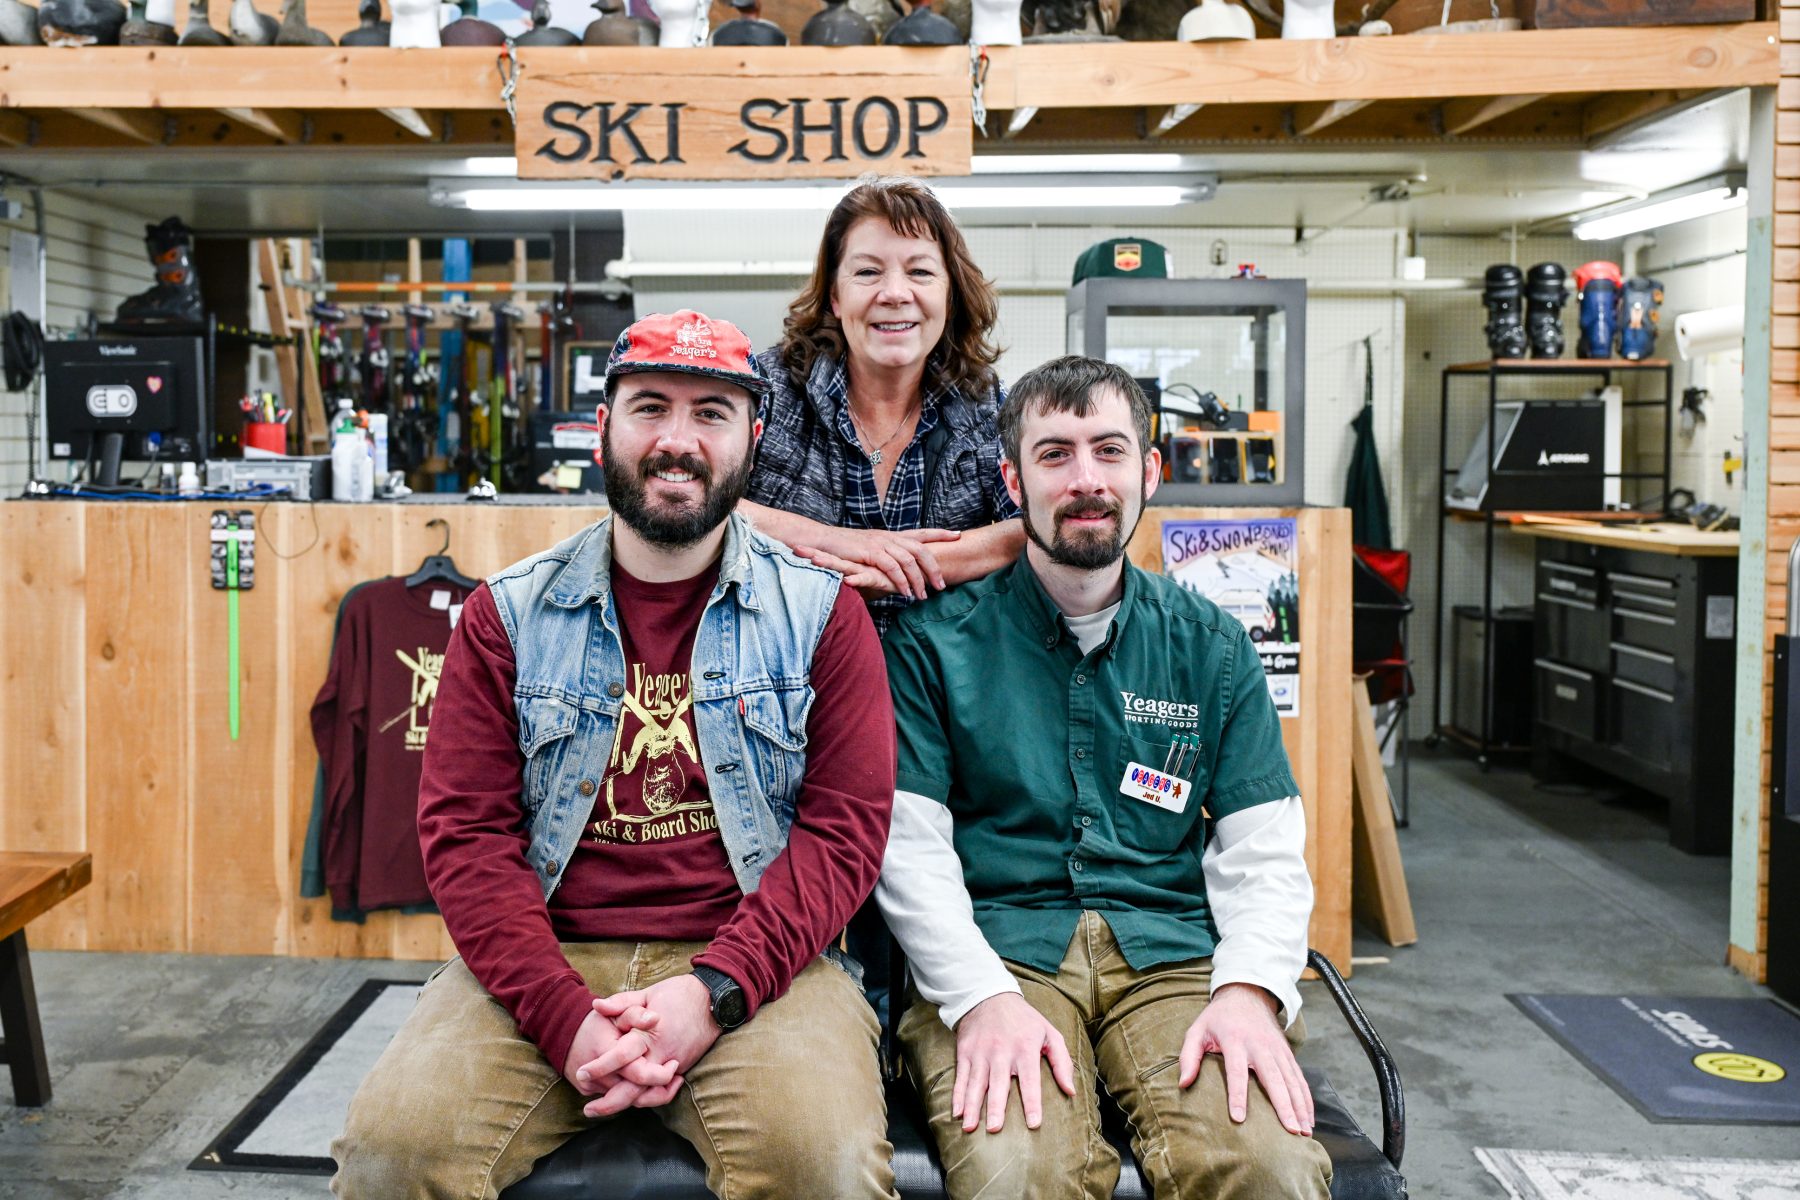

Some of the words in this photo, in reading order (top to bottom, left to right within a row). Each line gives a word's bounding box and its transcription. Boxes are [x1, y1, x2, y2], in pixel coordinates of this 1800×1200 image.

[534, 101, 688, 165] SKI
[726, 96, 949, 162] SHOP
[1120, 691, 1199, 718] Yeagers
[1124, 715, 1166, 725] SPORTING
[1167, 718, 1198, 729] GOODS
[1142, 791, 1155, 801] Jed
[622, 824, 637, 843] &
[641, 813, 687, 843] Board
